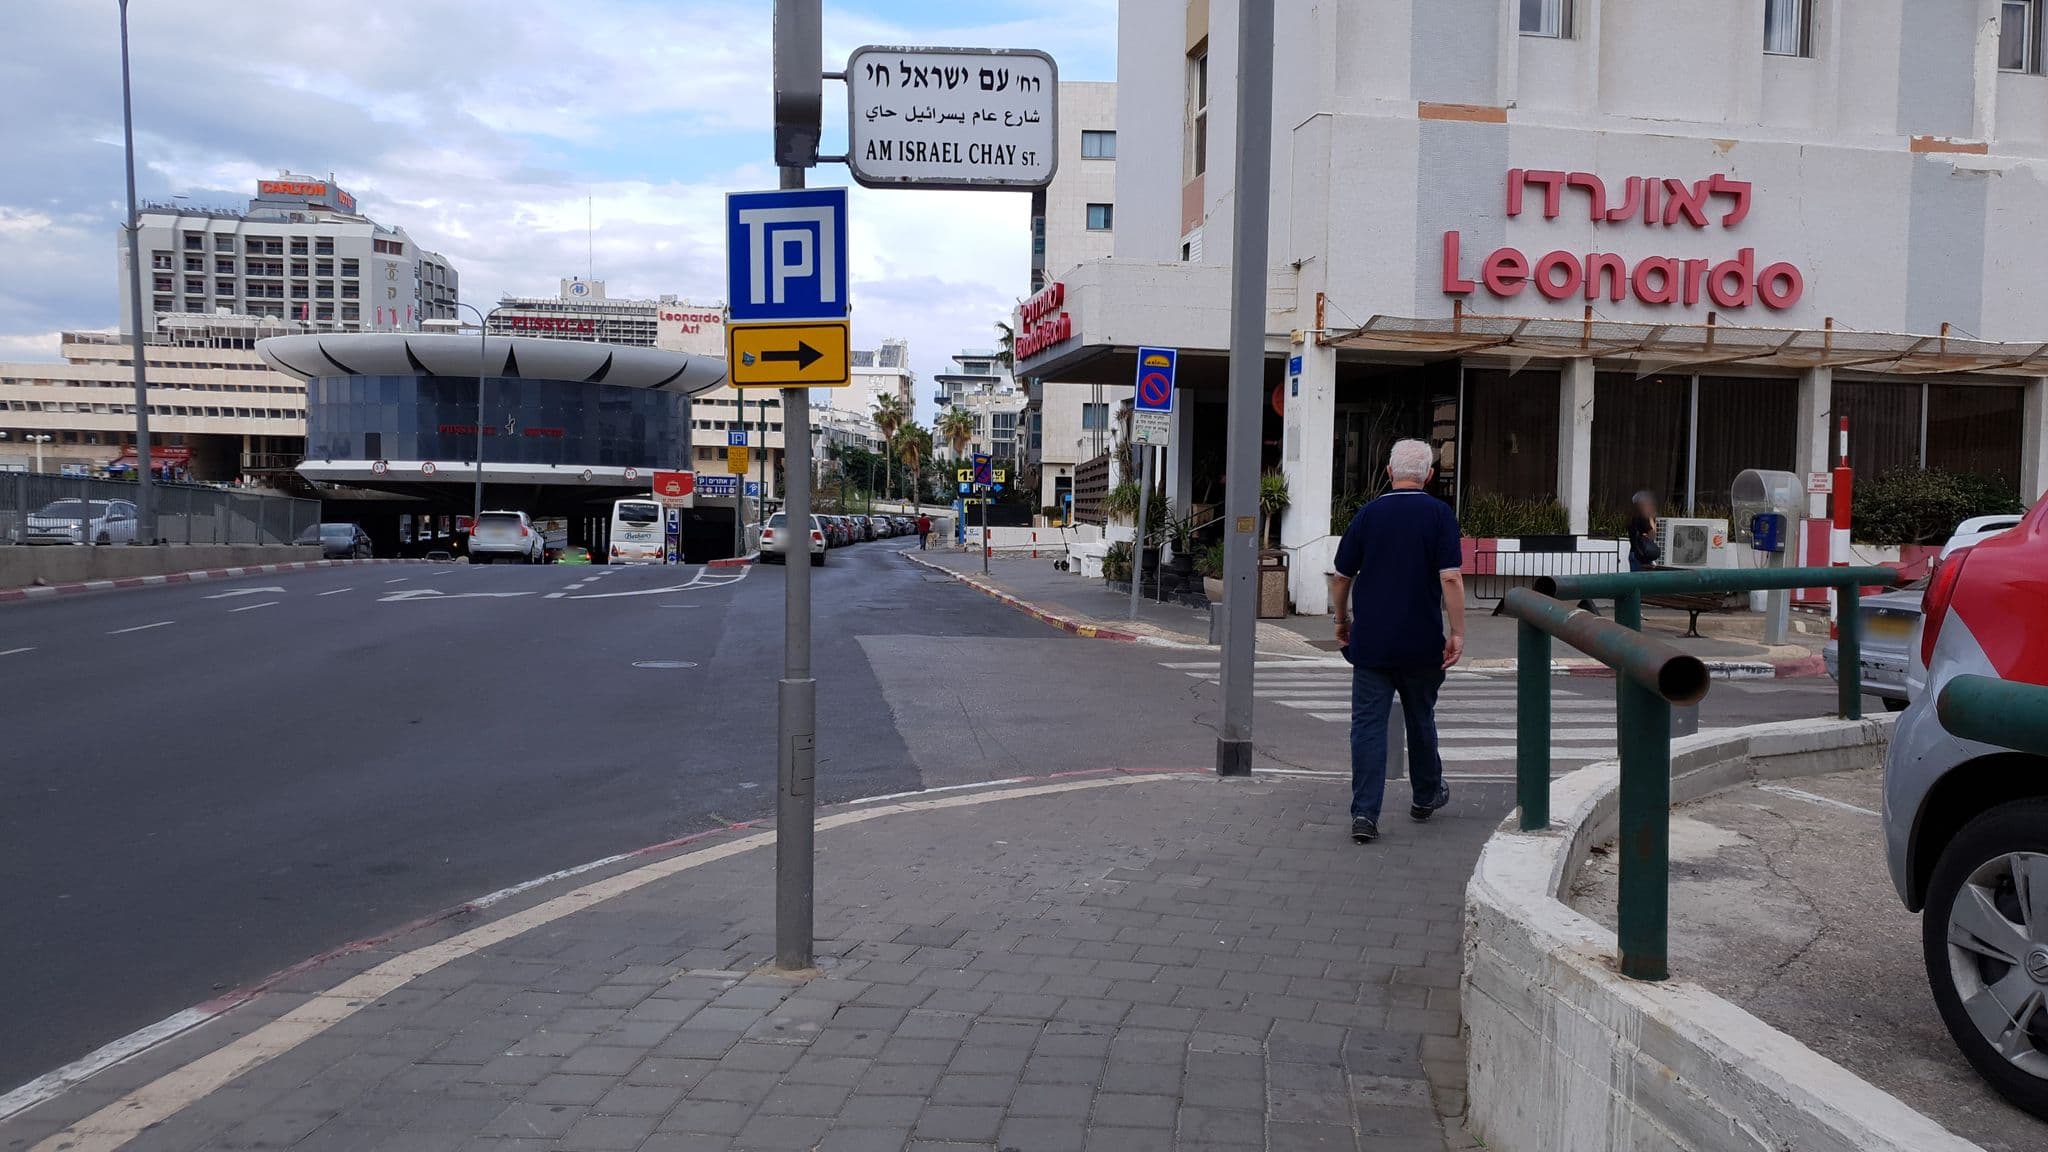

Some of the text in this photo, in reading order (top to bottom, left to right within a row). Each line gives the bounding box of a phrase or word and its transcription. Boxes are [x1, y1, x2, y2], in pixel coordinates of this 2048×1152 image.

[866, 63, 890, 88] חי
[900, 59, 968, 89] ישראל
[979, 67, 1009, 91] עם
[866, 105, 1040, 126] شارع عام يسرائيل حاي
[866, 139, 1040, 166] AM ISRAEL CHAY ST.
[262, 182, 326, 196] CARLTON
[1507, 169, 1752, 227] לאונרדו
[1443, 231, 1803, 310] Leonardo
[511, 316, 595, 333] PUSSYCAT
[660, 311, 720, 324] Leonardo
[681, 324, 700, 334] Art
